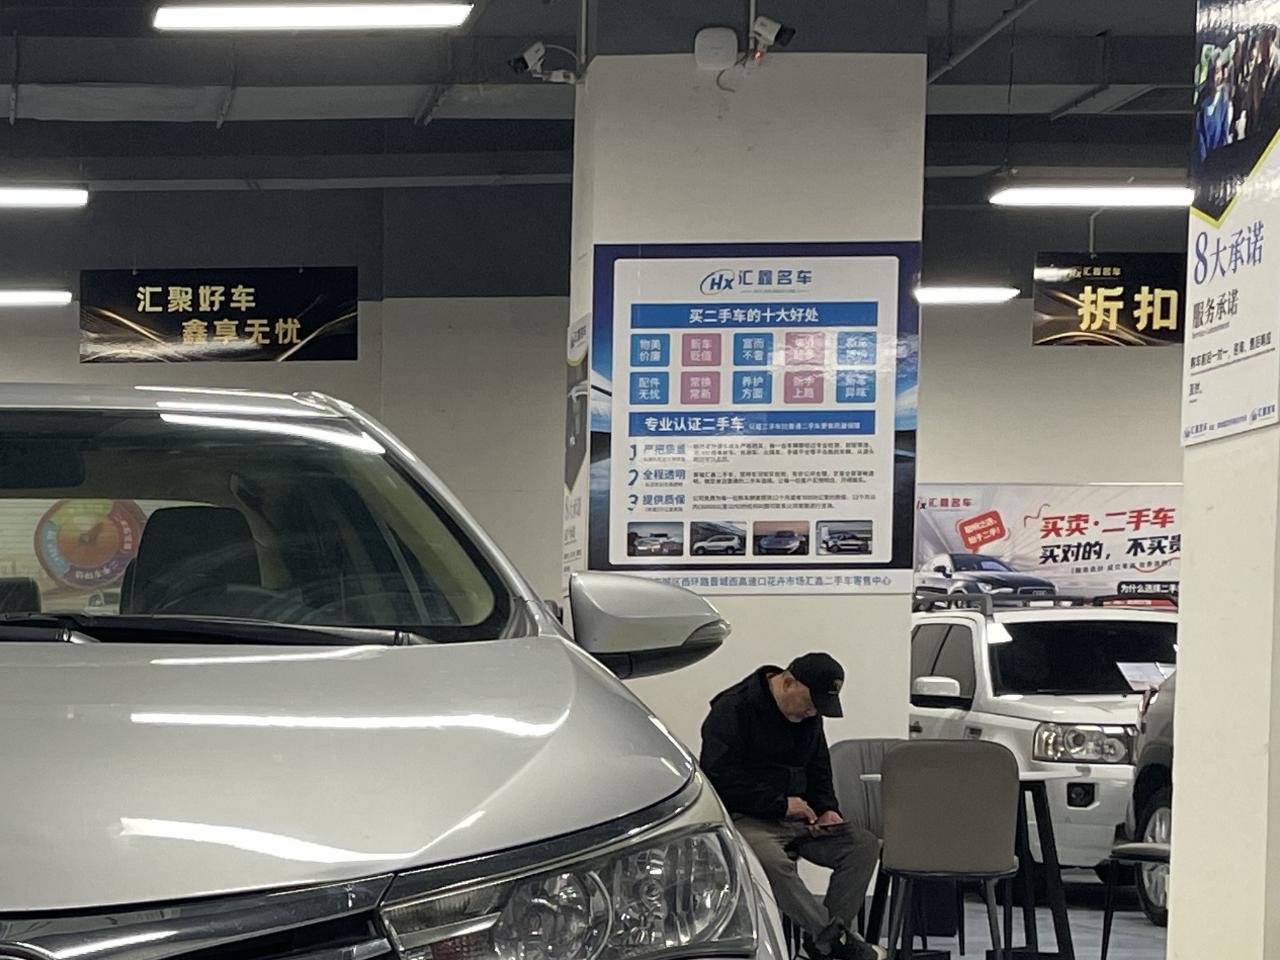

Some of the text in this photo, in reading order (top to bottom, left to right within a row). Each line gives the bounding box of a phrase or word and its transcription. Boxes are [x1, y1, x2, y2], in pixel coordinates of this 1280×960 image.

[1193, 219, 1265, 286] 8大承诺
[737, 269, 813, 286] 汇鑫名车
[136, 285, 257, 313] 汇聚好车
[1077, 285, 1180, 333] 折扣
[1192, 288, 1240, 330] 服务承诺
[688, 306, 820, 324] 买二手车的十大好处
[180, 317, 302, 346] 鑫享无忧
[644, 416, 746, 432] 专业认证二手车
[627, 468, 639, 487] 2
[642, 469, 686, 481] 全程透明
[627, 494, 639, 511] 3
[1039, 507, 1177, 539] 买卖·二手车
[1120, 583, 1179, 594] 为什么选择二手
